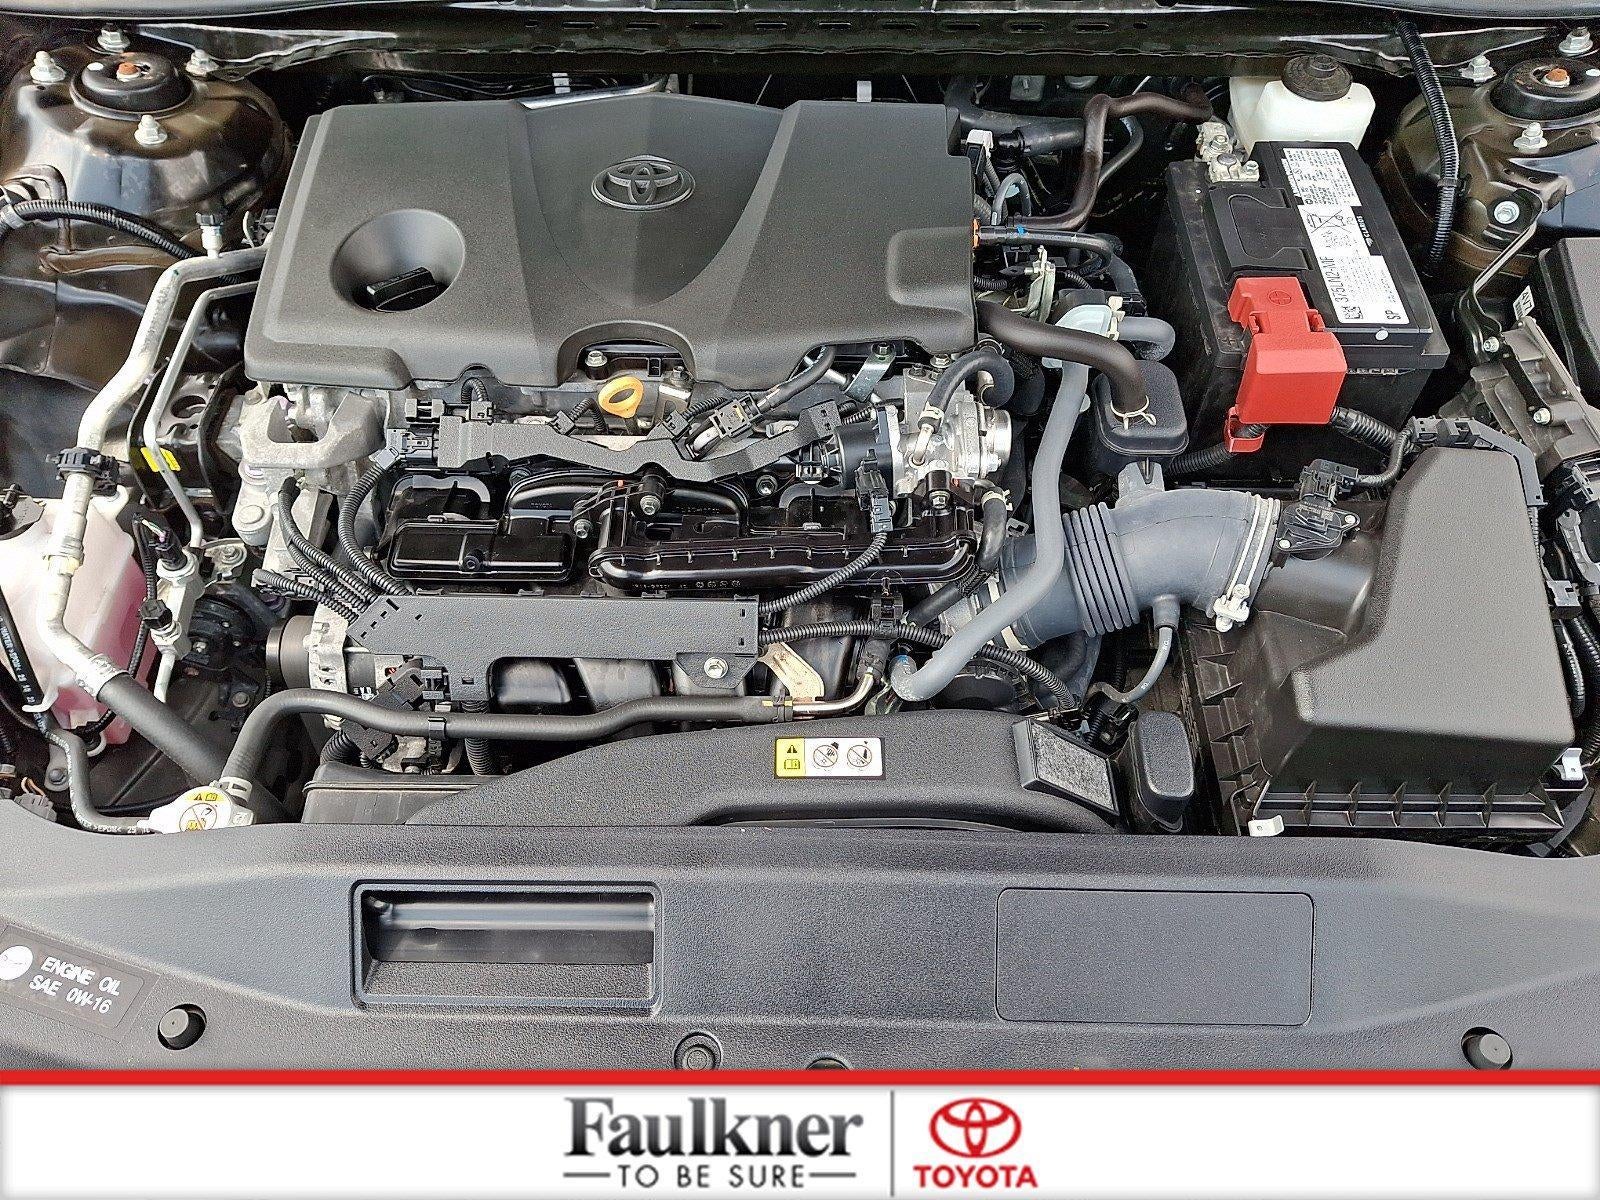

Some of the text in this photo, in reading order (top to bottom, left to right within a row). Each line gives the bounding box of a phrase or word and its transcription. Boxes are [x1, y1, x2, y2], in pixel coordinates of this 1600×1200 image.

[1384, 309, 1401, 320] SP
[29, 974, 112, 1014] SAE 0W-16
[41, 956, 121, 997] ENGINE OIL
